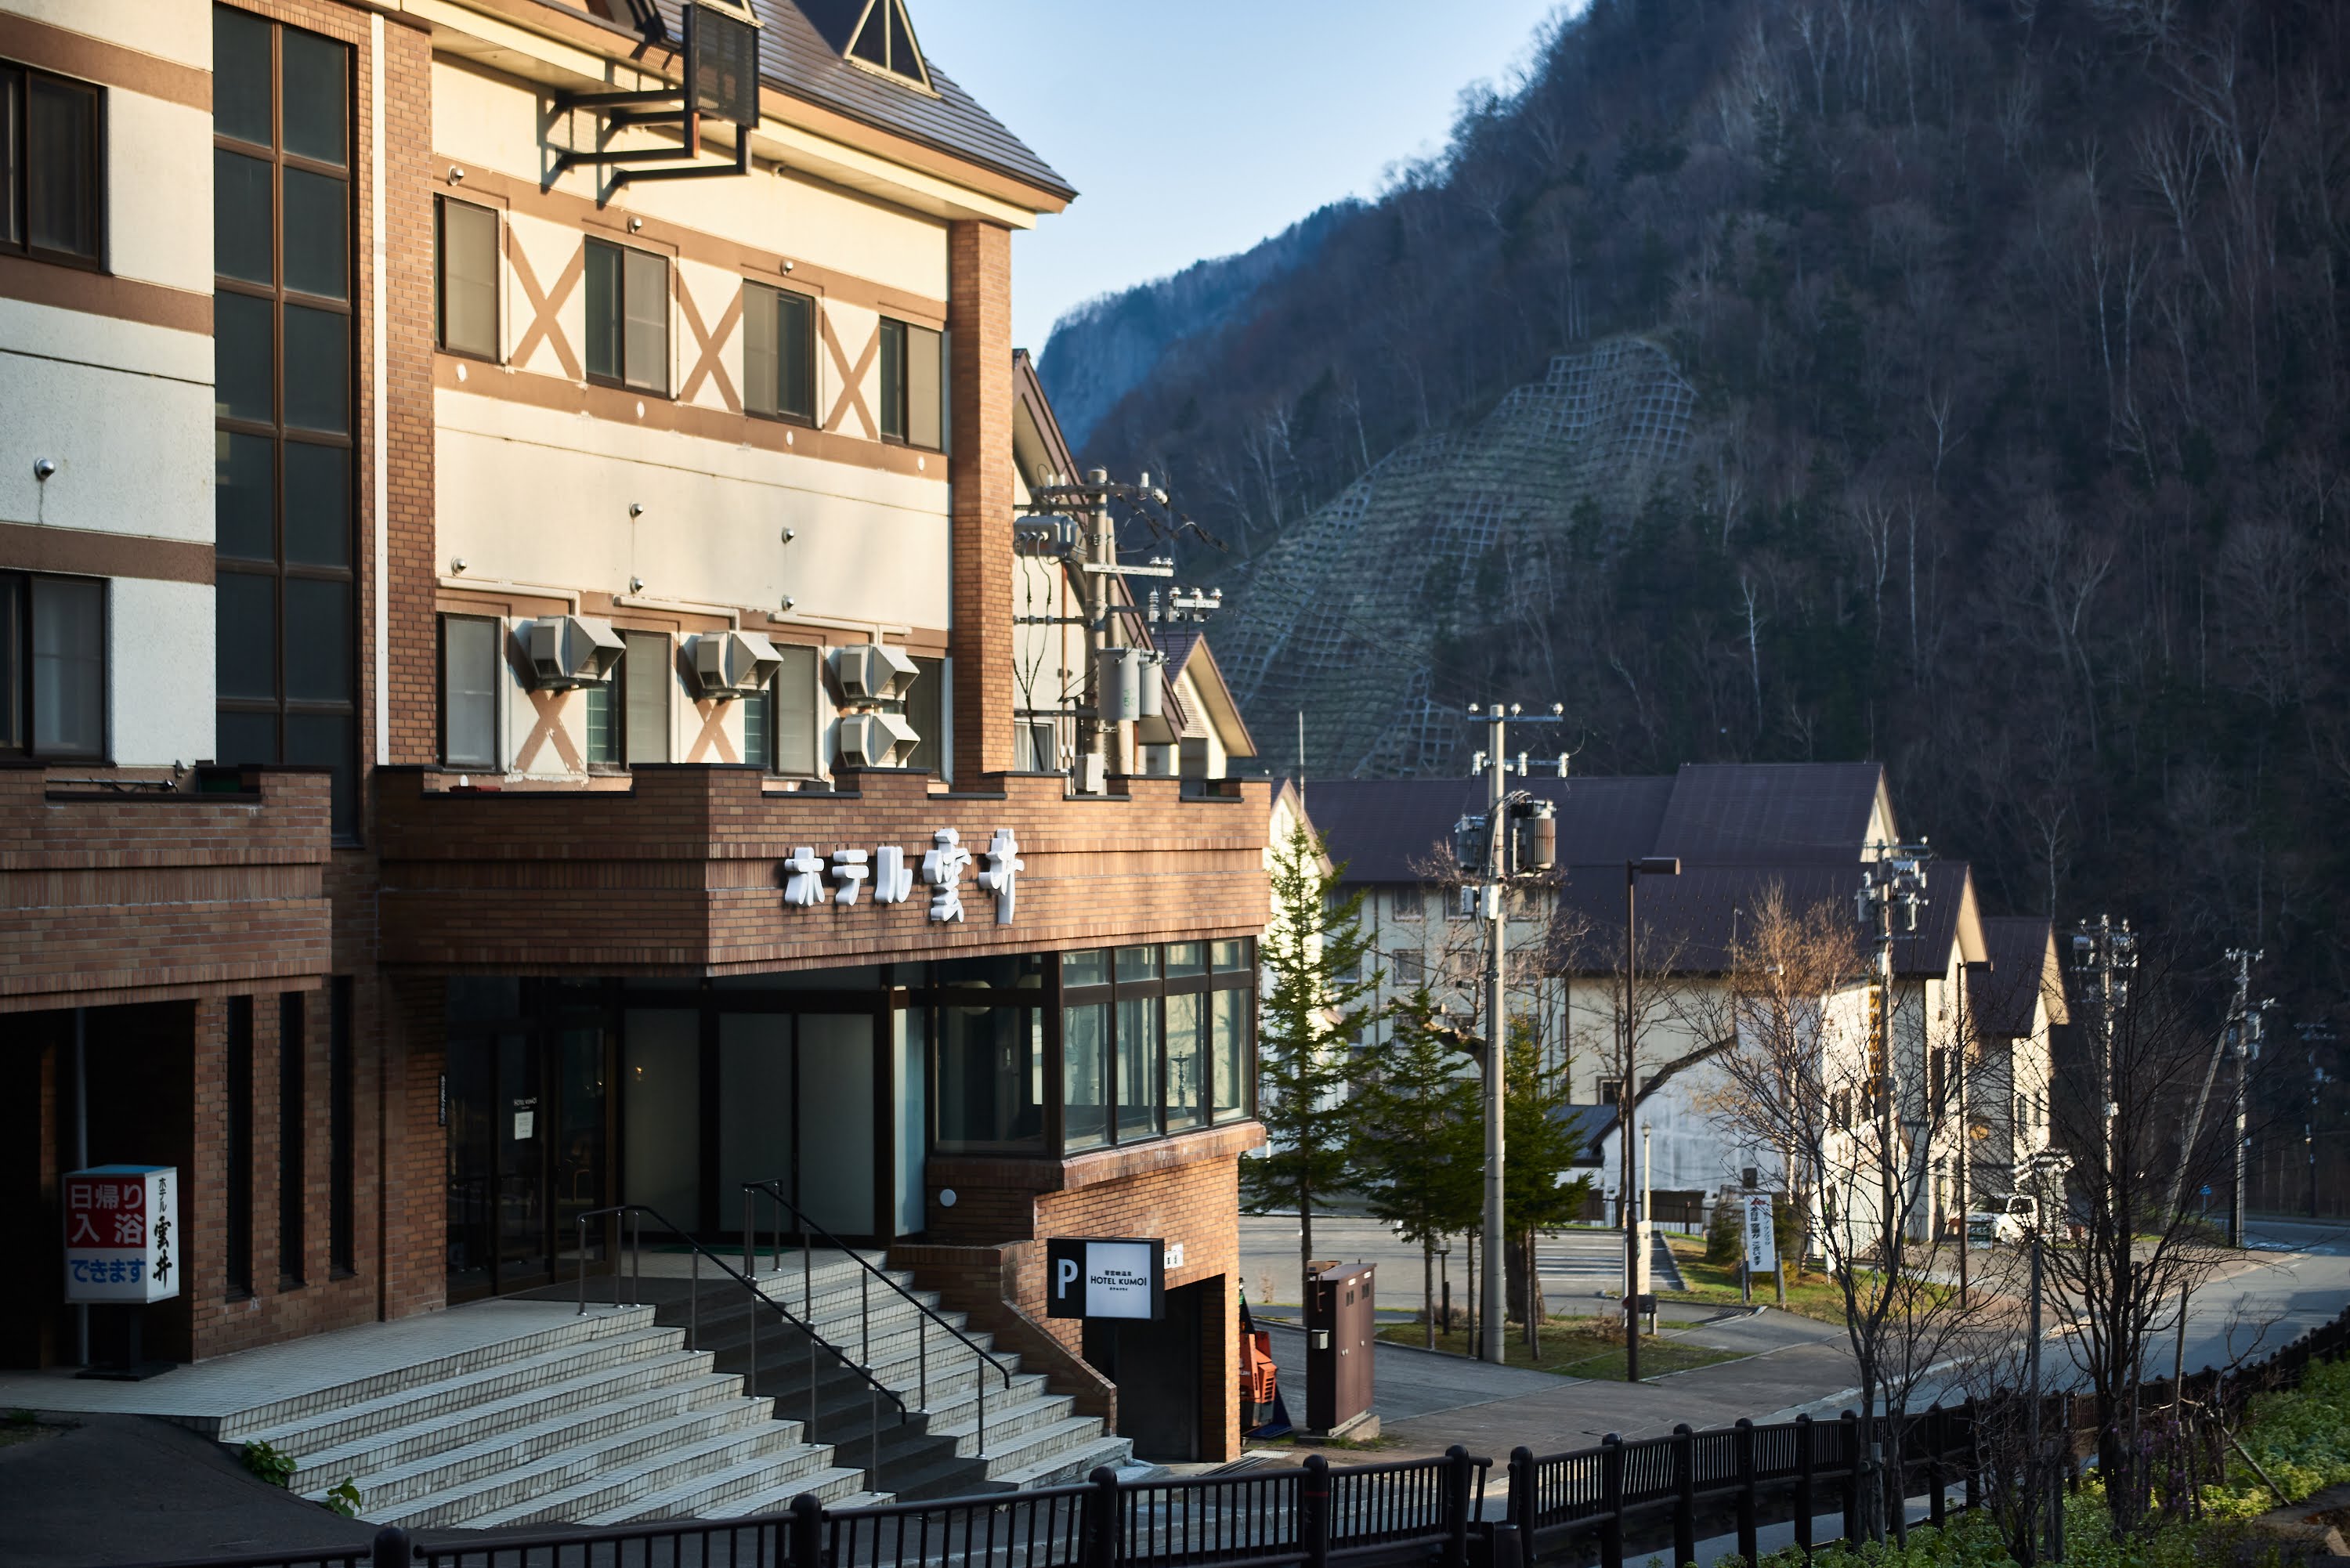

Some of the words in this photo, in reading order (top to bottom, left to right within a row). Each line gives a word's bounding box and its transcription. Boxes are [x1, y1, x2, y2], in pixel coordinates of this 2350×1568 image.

[784, 828, 1025, 925] ホテル雲井
[70, 1183, 143, 1210] 日帰り
[70, 1258, 146, 1283] できます
[1058, 1259, 1078, 1299] P
[1090, 1275, 1115, 1285] HOTEL
[1119, 1277, 1147, 1286] KUMOI
